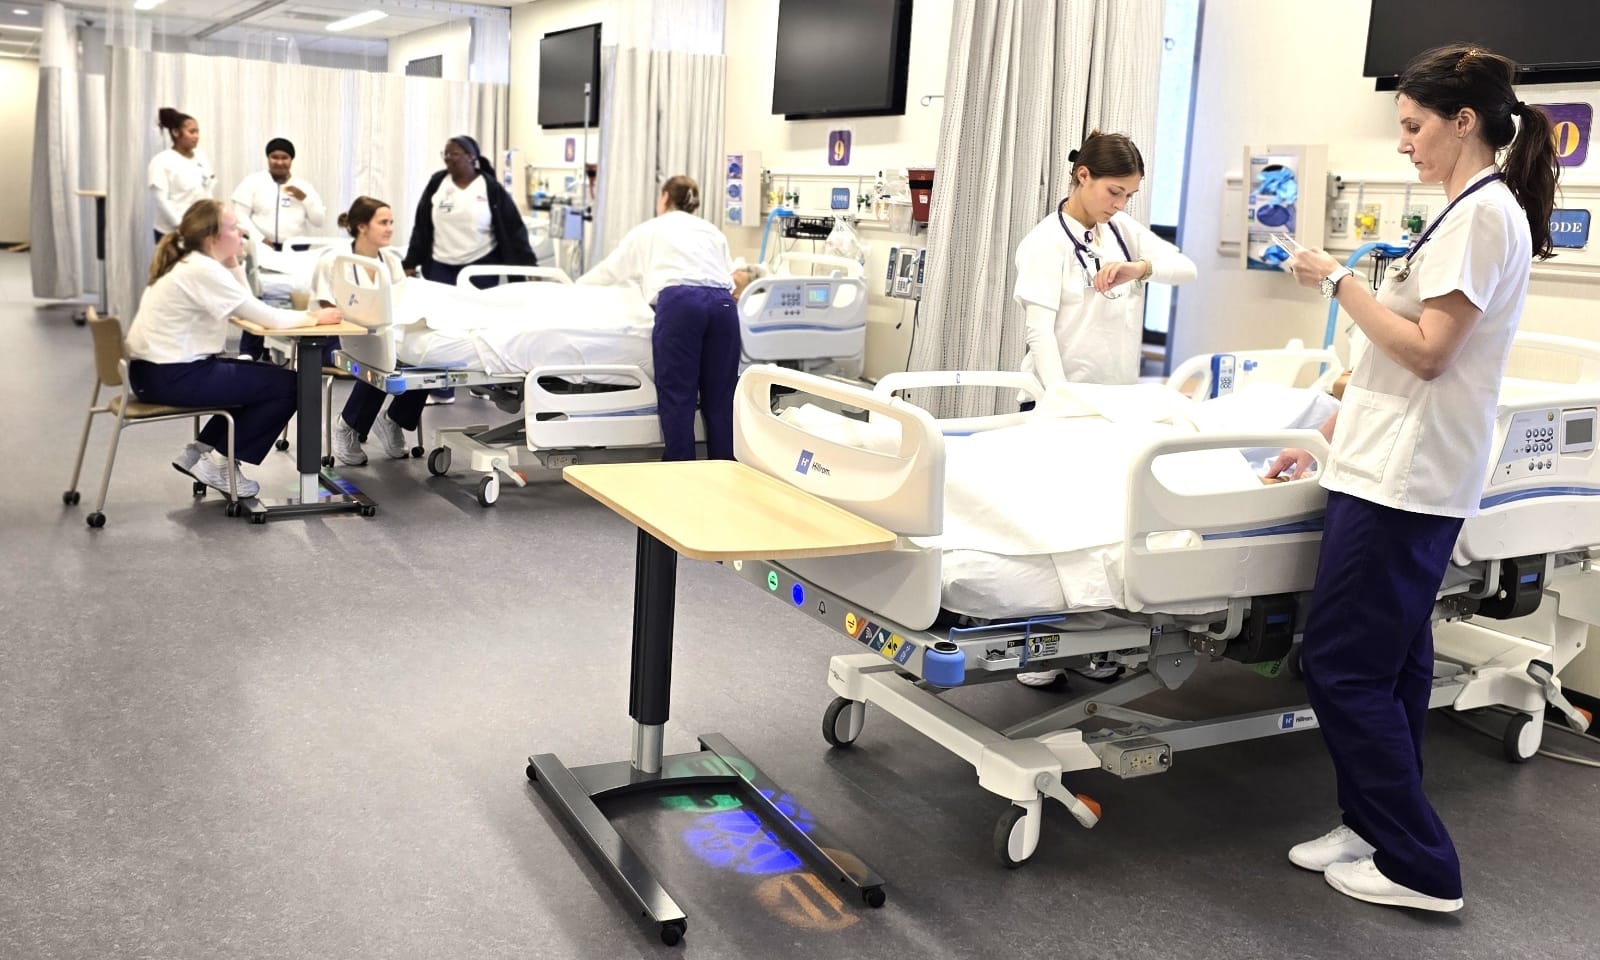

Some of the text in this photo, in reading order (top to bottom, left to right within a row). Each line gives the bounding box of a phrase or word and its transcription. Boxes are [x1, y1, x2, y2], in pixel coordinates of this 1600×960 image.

[1551, 121, 1580, 157] 0
[834, 140, 845, 161] 9
[1550, 221, 1582, 233] ODE
